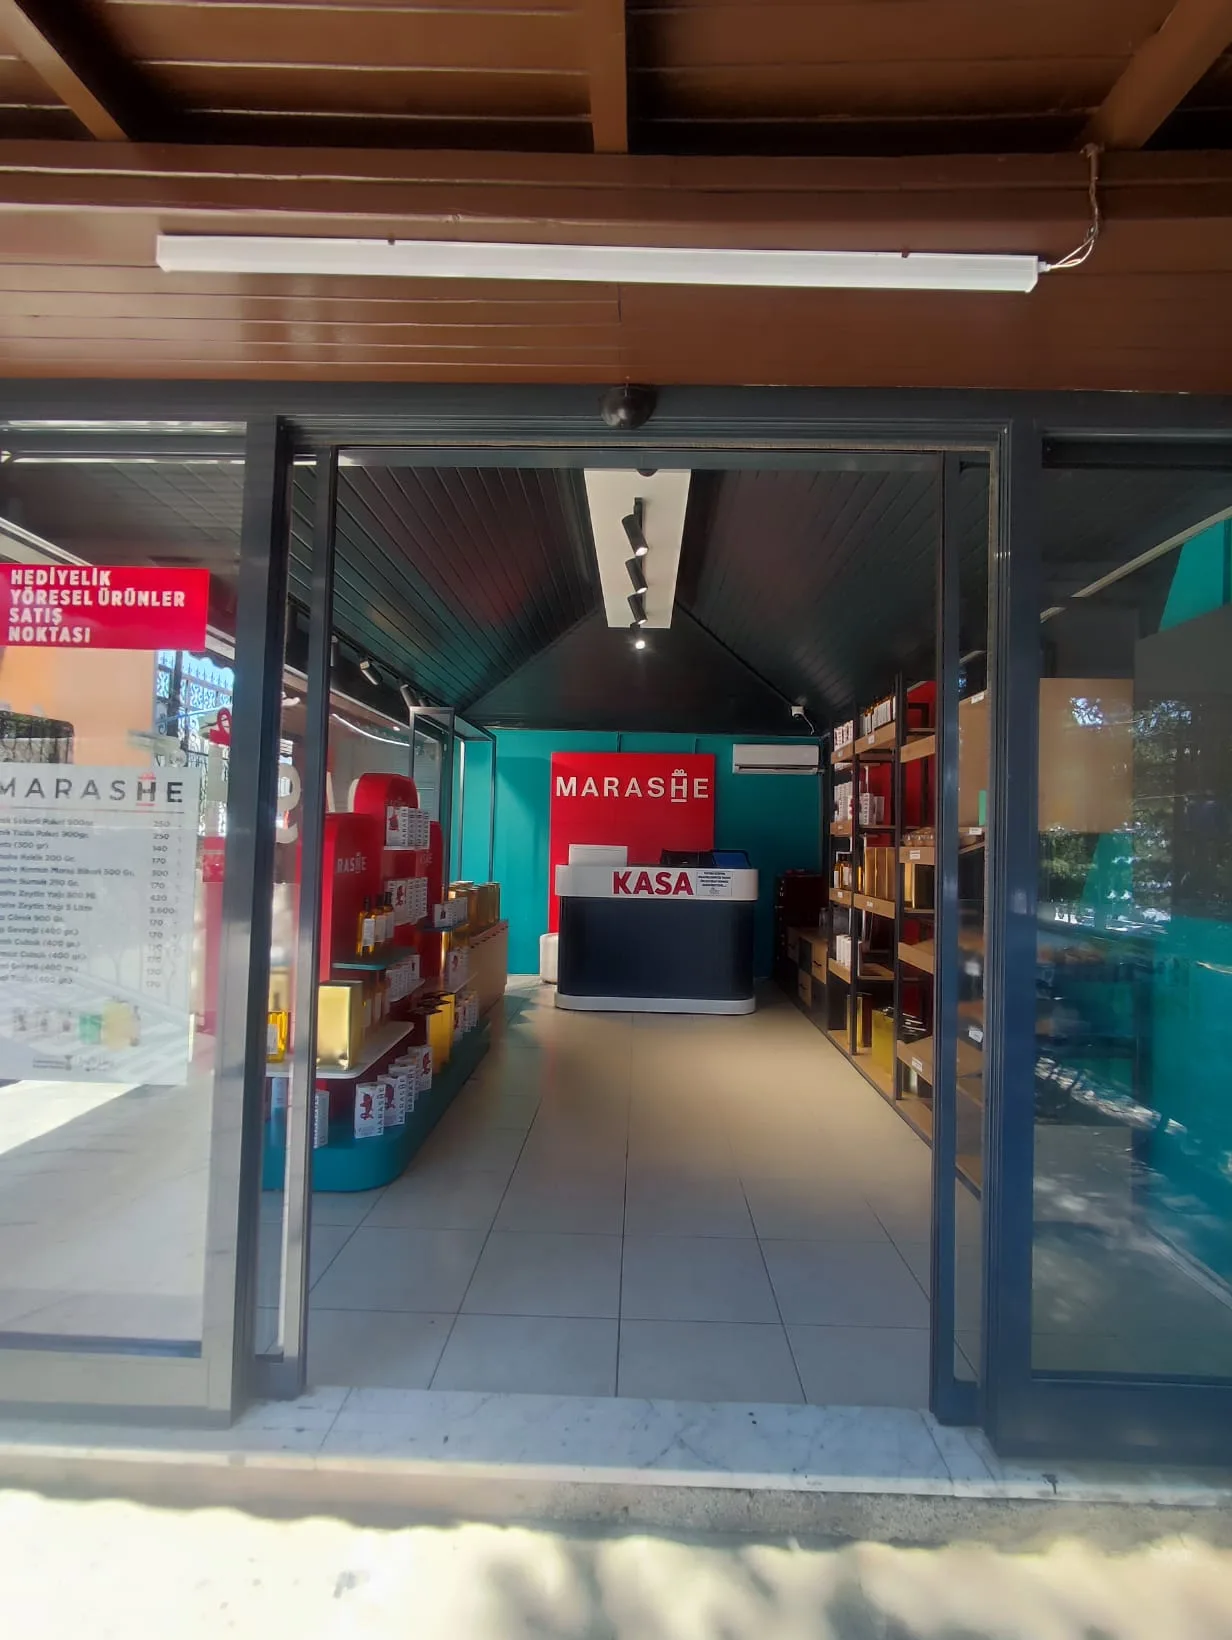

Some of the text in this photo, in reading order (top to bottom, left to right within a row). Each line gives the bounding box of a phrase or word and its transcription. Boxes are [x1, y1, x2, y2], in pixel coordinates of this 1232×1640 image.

[11, 567, 112, 586] HEDİYELİK
[10, 587, 185, 607] YÖRESEL ÜRÜNLER
[9, 607, 63, 625] SATIŞ
[8, 626, 90, 643] NOKTASI
[556, 770, 709, 802] MARASHE
[612, 871, 694, 896] KASA
